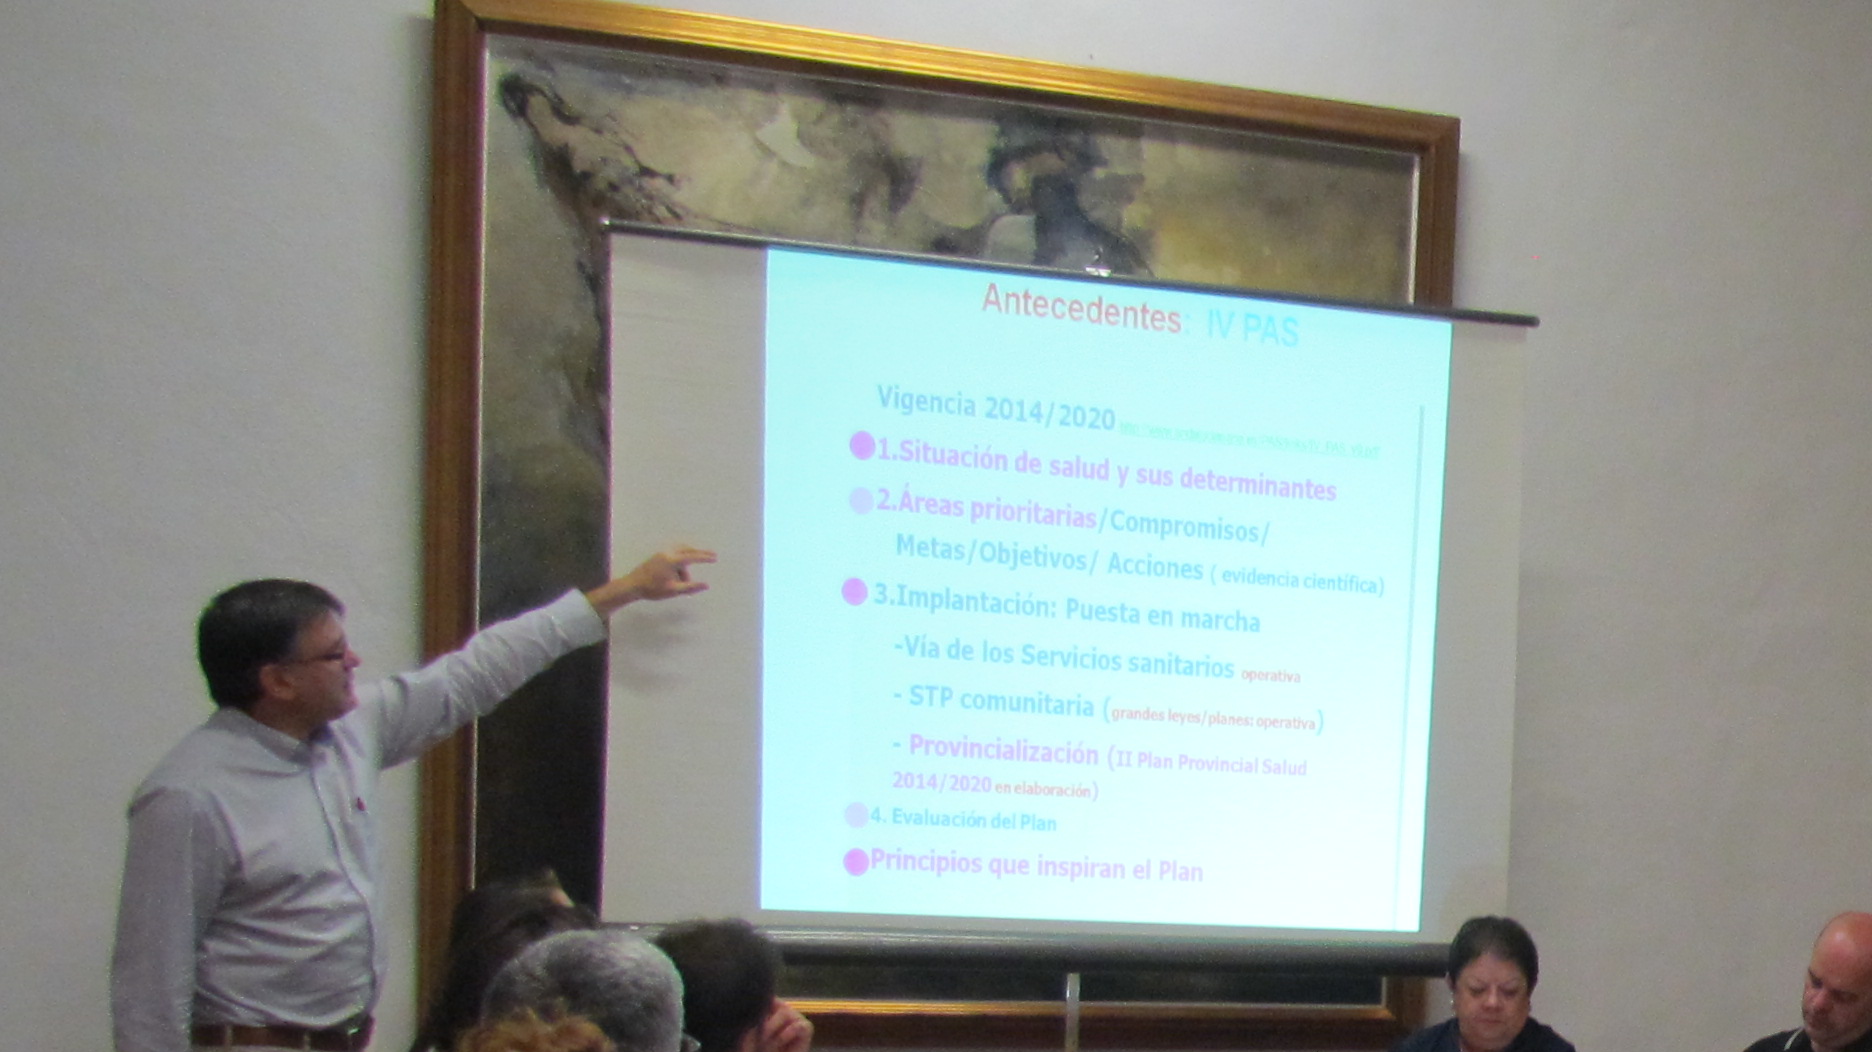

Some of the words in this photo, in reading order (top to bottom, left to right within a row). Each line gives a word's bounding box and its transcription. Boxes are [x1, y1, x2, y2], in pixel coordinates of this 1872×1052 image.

[1206, 308, 1236, 340] IV
[1243, 311, 1300, 348] PAS
[876, 384, 977, 417] Vigencia
[984, 396, 1117, 430] 2014/2020
[1014, 450, 1042, 475] de
[1049, 454, 1111, 481] salud
[1116, 464, 1130, 488] y
[1136, 466, 1173, 487] sus
[1180, 465, 1338, 501] determinantes
[1107, 551, 1204, 581] Acciones
[1221, 567, 1300, 589] evidencia
[1065, 597, 1141, 625] Puesta
[1147, 608, 1174, 628] en
[1180, 608, 1262, 633] marcha
[946, 637, 975, 662] de
[982, 639, 1015, 664] los
[1021, 642, 1123, 672] Servicios
[1127, 651, 1236, 679] sanitarios
[1241, 667, 1302, 685] operativa
[909, 683, 954, 708] STP
[960, 690, 1095, 718] comunitaria
[909, 732, 1100, 766] Provincialización
[1137, 750, 1174, 770] Plan
[1178, 753, 1259, 774] Provincial
[1261, 757, 1308, 777] Salud
[892, 770, 993, 794] 2014/2020
[994, 782, 1012, 795] en
[891, 807, 987, 829] Evaluación
[990, 812, 1017, 831] del
[1020, 813, 1058, 832] Plan
[870, 847, 983, 878] Principios
[987, 856, 1031, 880] que
[1037, 853, 1126, 883] inspiran
[1132, 858, 1152, 880] el
[1158, 859, 1205, 883] Plan
